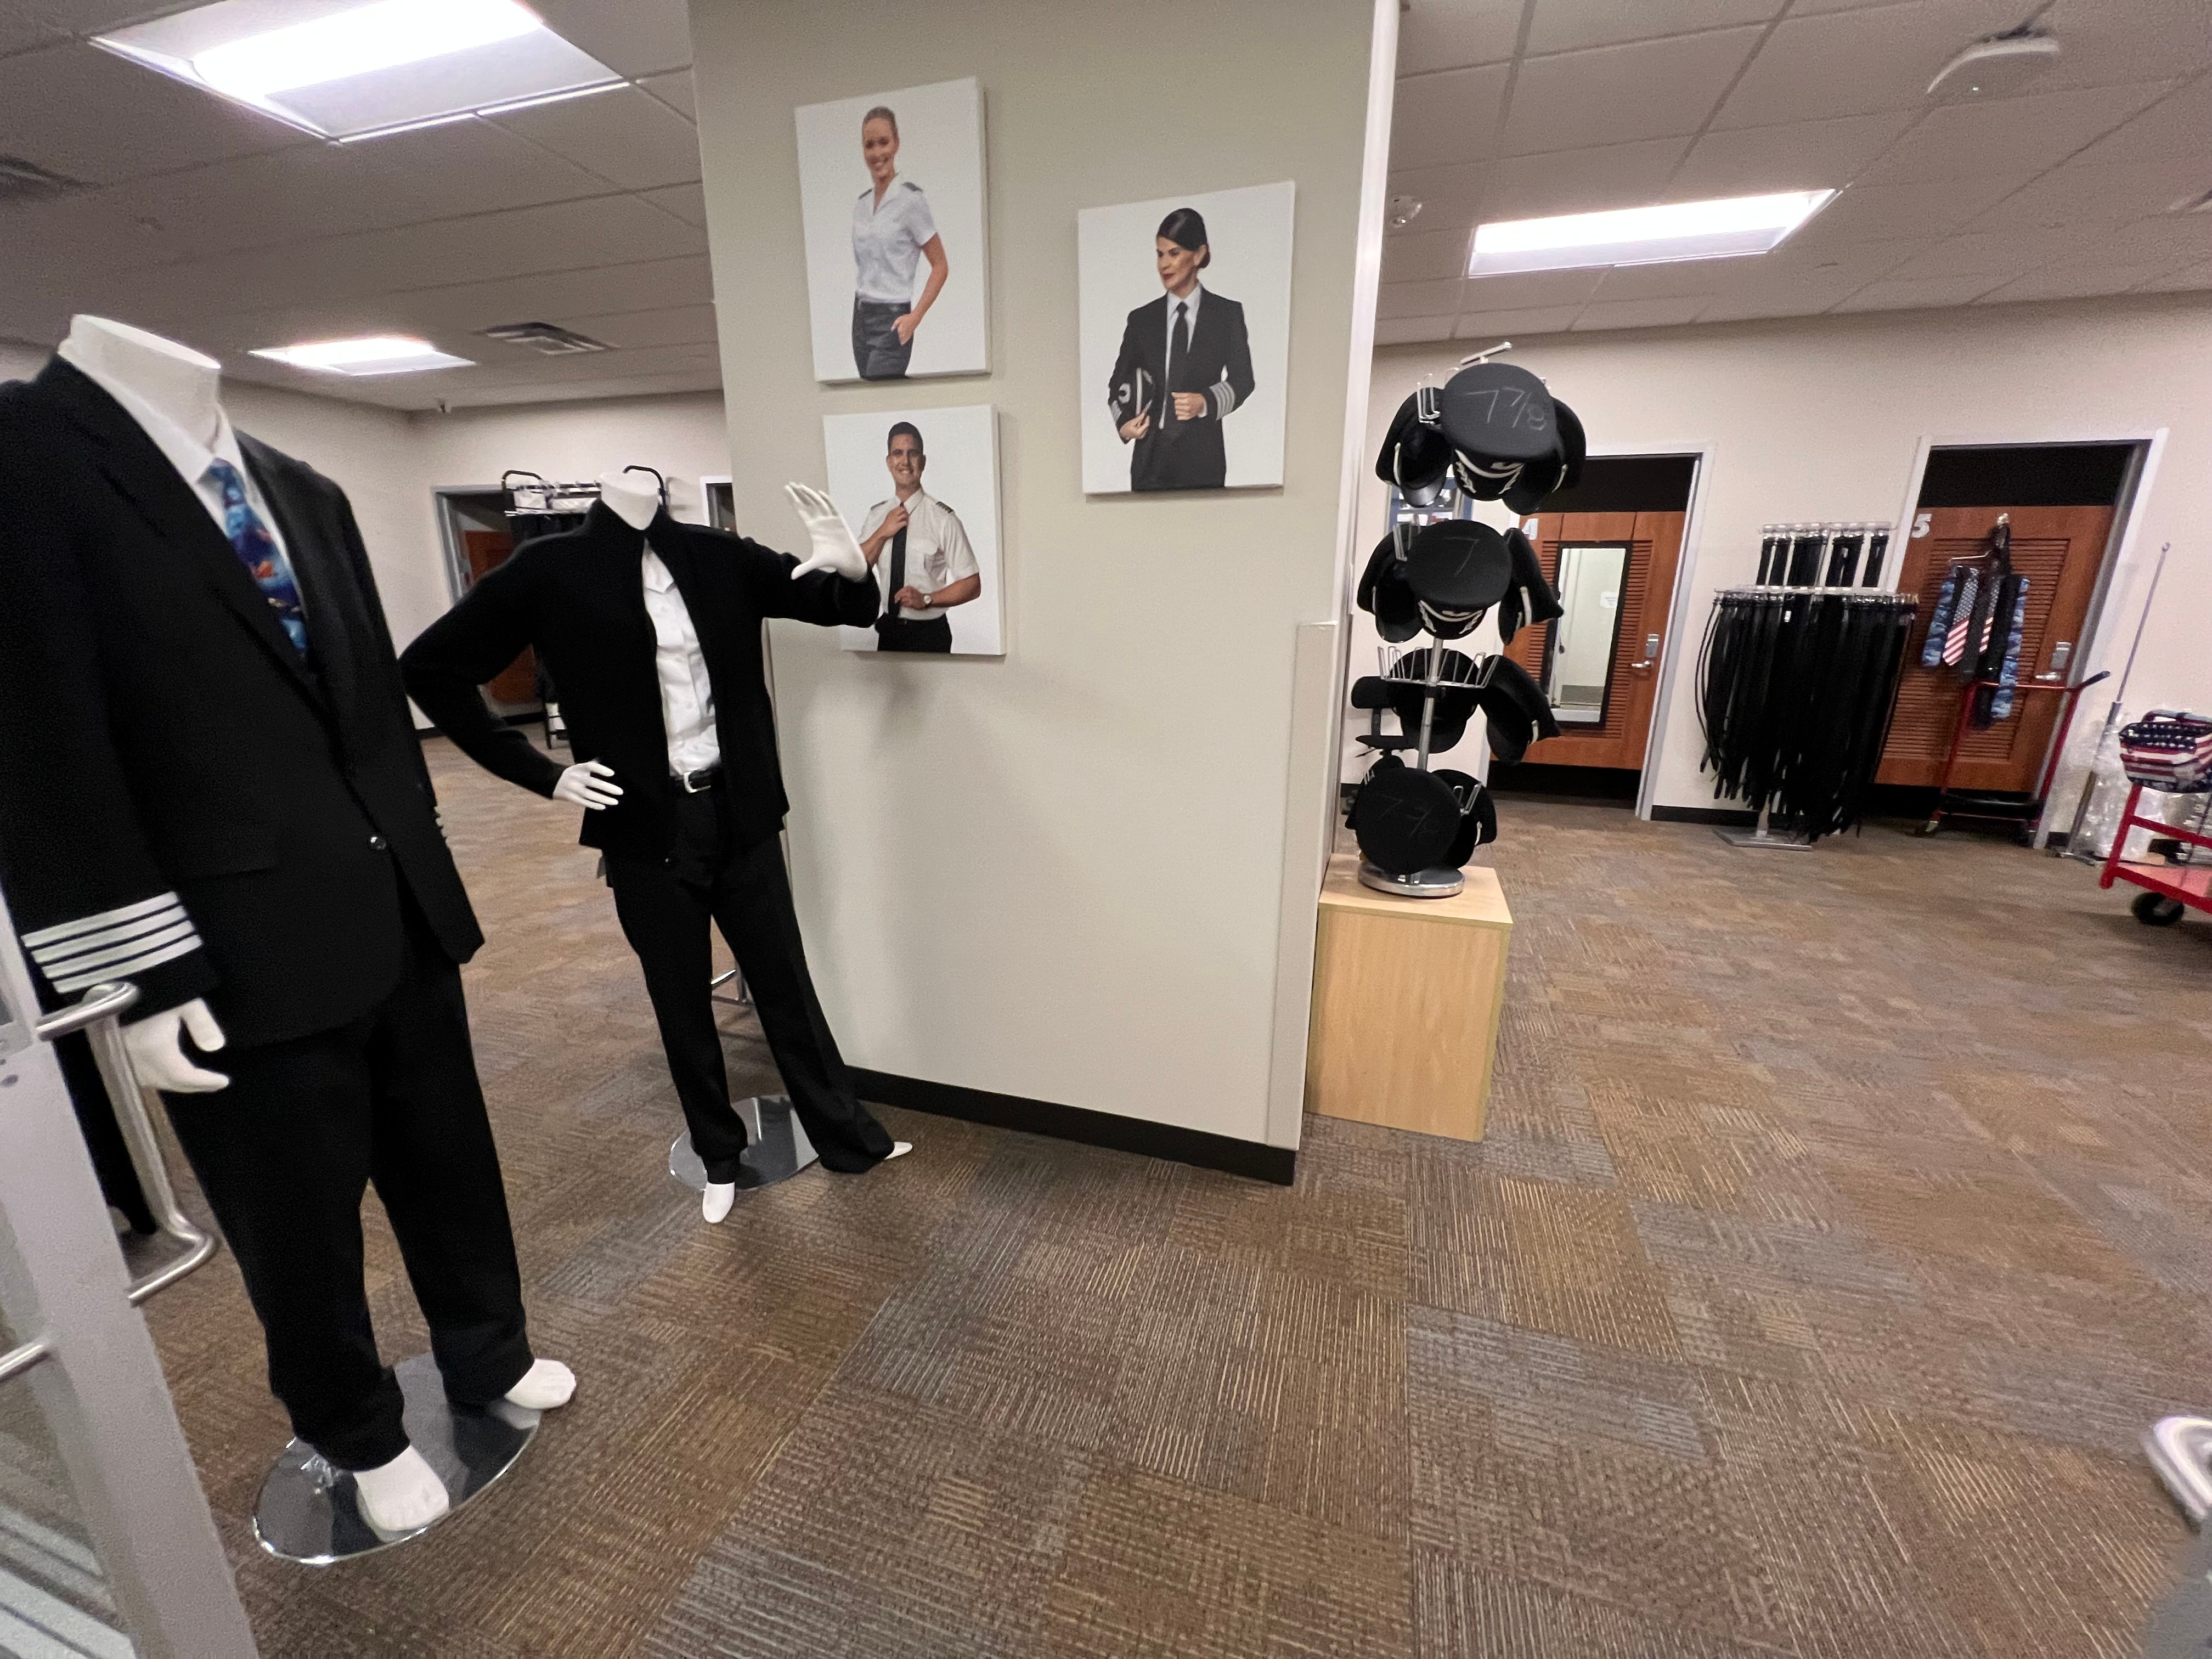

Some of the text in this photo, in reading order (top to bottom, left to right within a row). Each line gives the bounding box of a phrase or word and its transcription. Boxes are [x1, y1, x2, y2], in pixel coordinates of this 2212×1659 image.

[1521, 518, 1538, 540] 4
[1911, 514, 1932, 538] 5
[1443, 535, 1481, 577] 7
